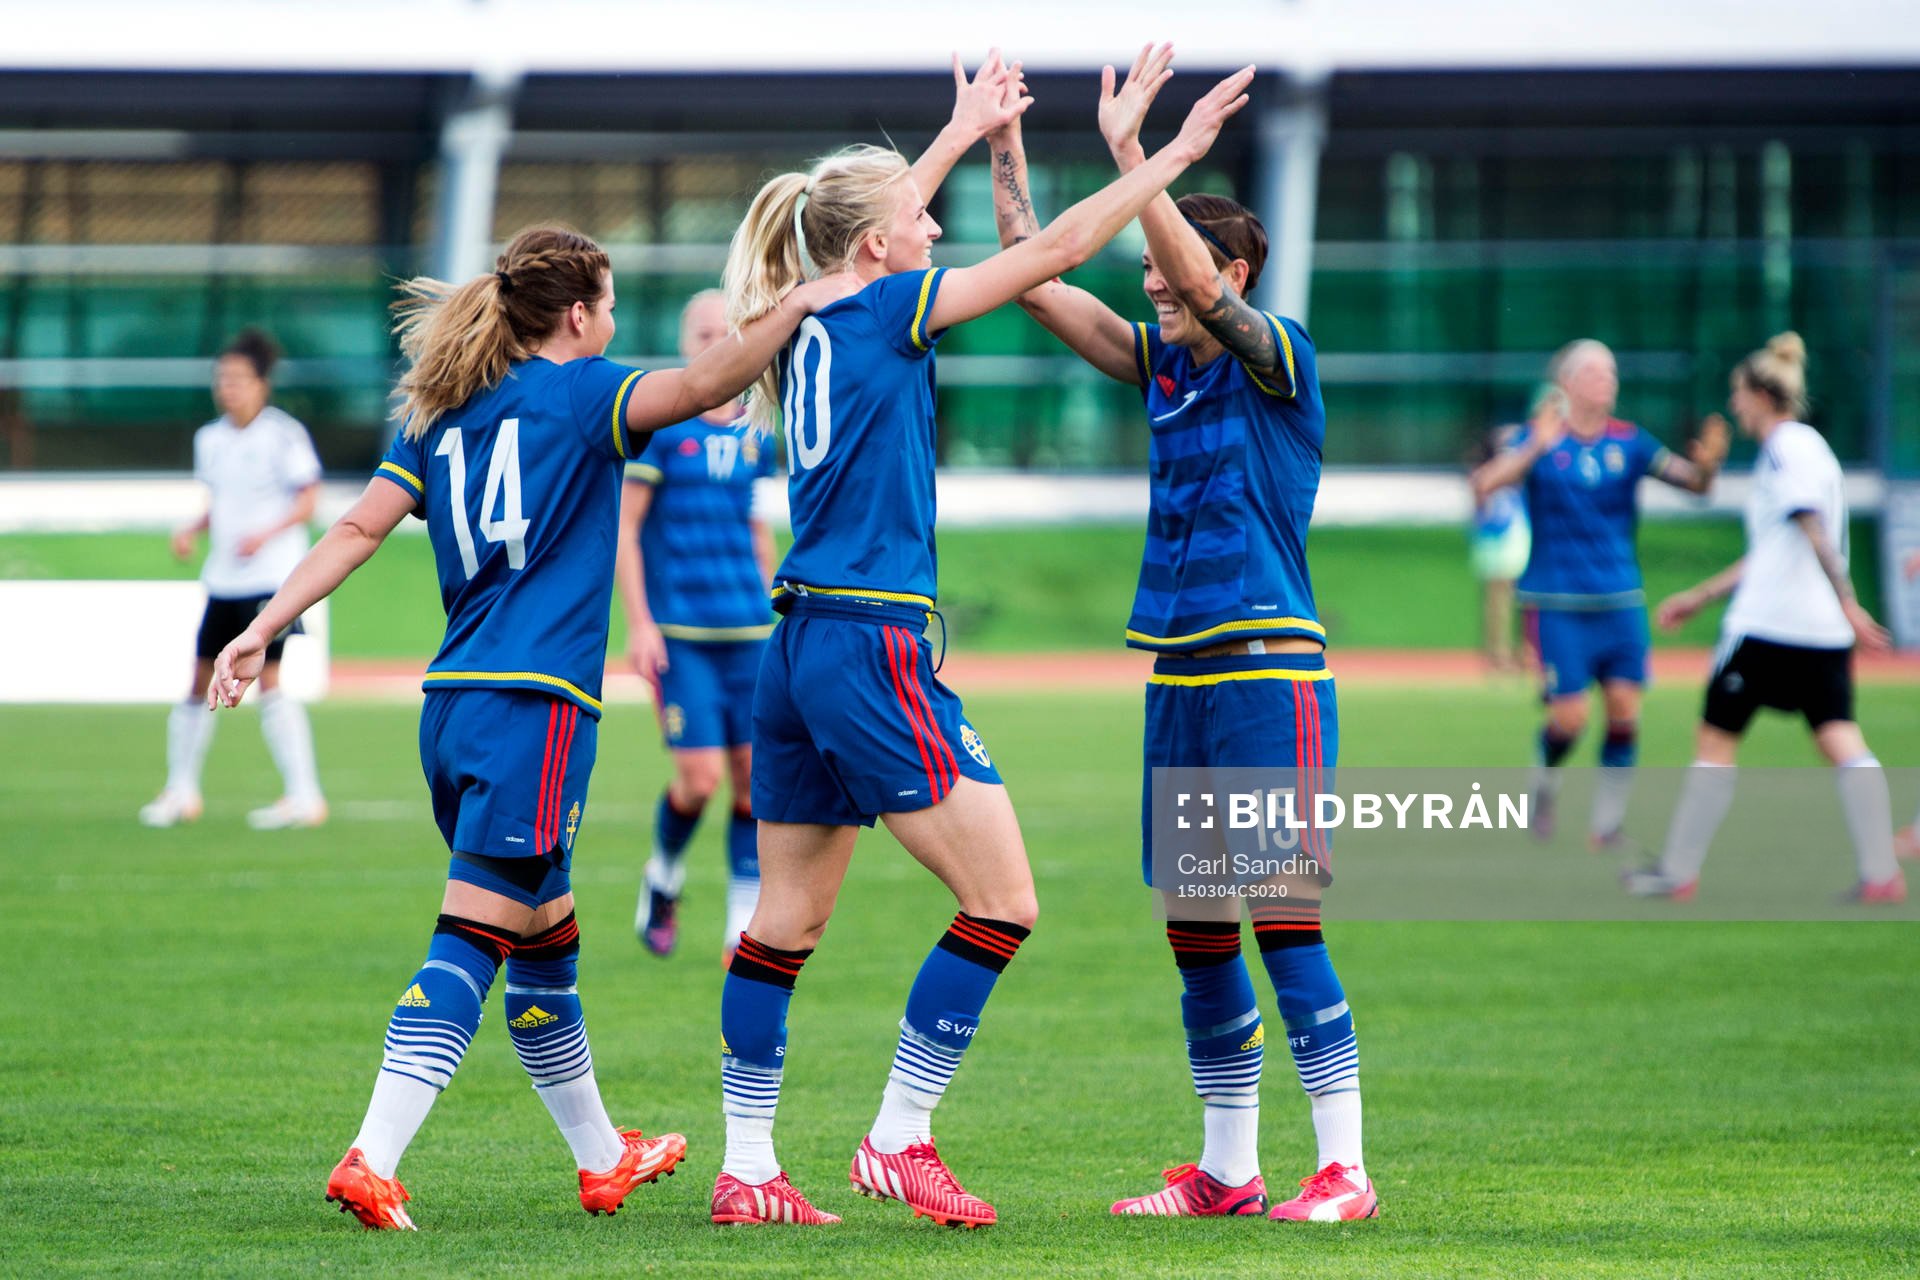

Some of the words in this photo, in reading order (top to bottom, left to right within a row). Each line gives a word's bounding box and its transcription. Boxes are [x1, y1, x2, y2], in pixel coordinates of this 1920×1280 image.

[784, 315, 832, 475] 10
[435, 418, 530, 580] 14
[1252, 787, 1300, 851] 15
[509, 1014, 559, 1029] adidas
